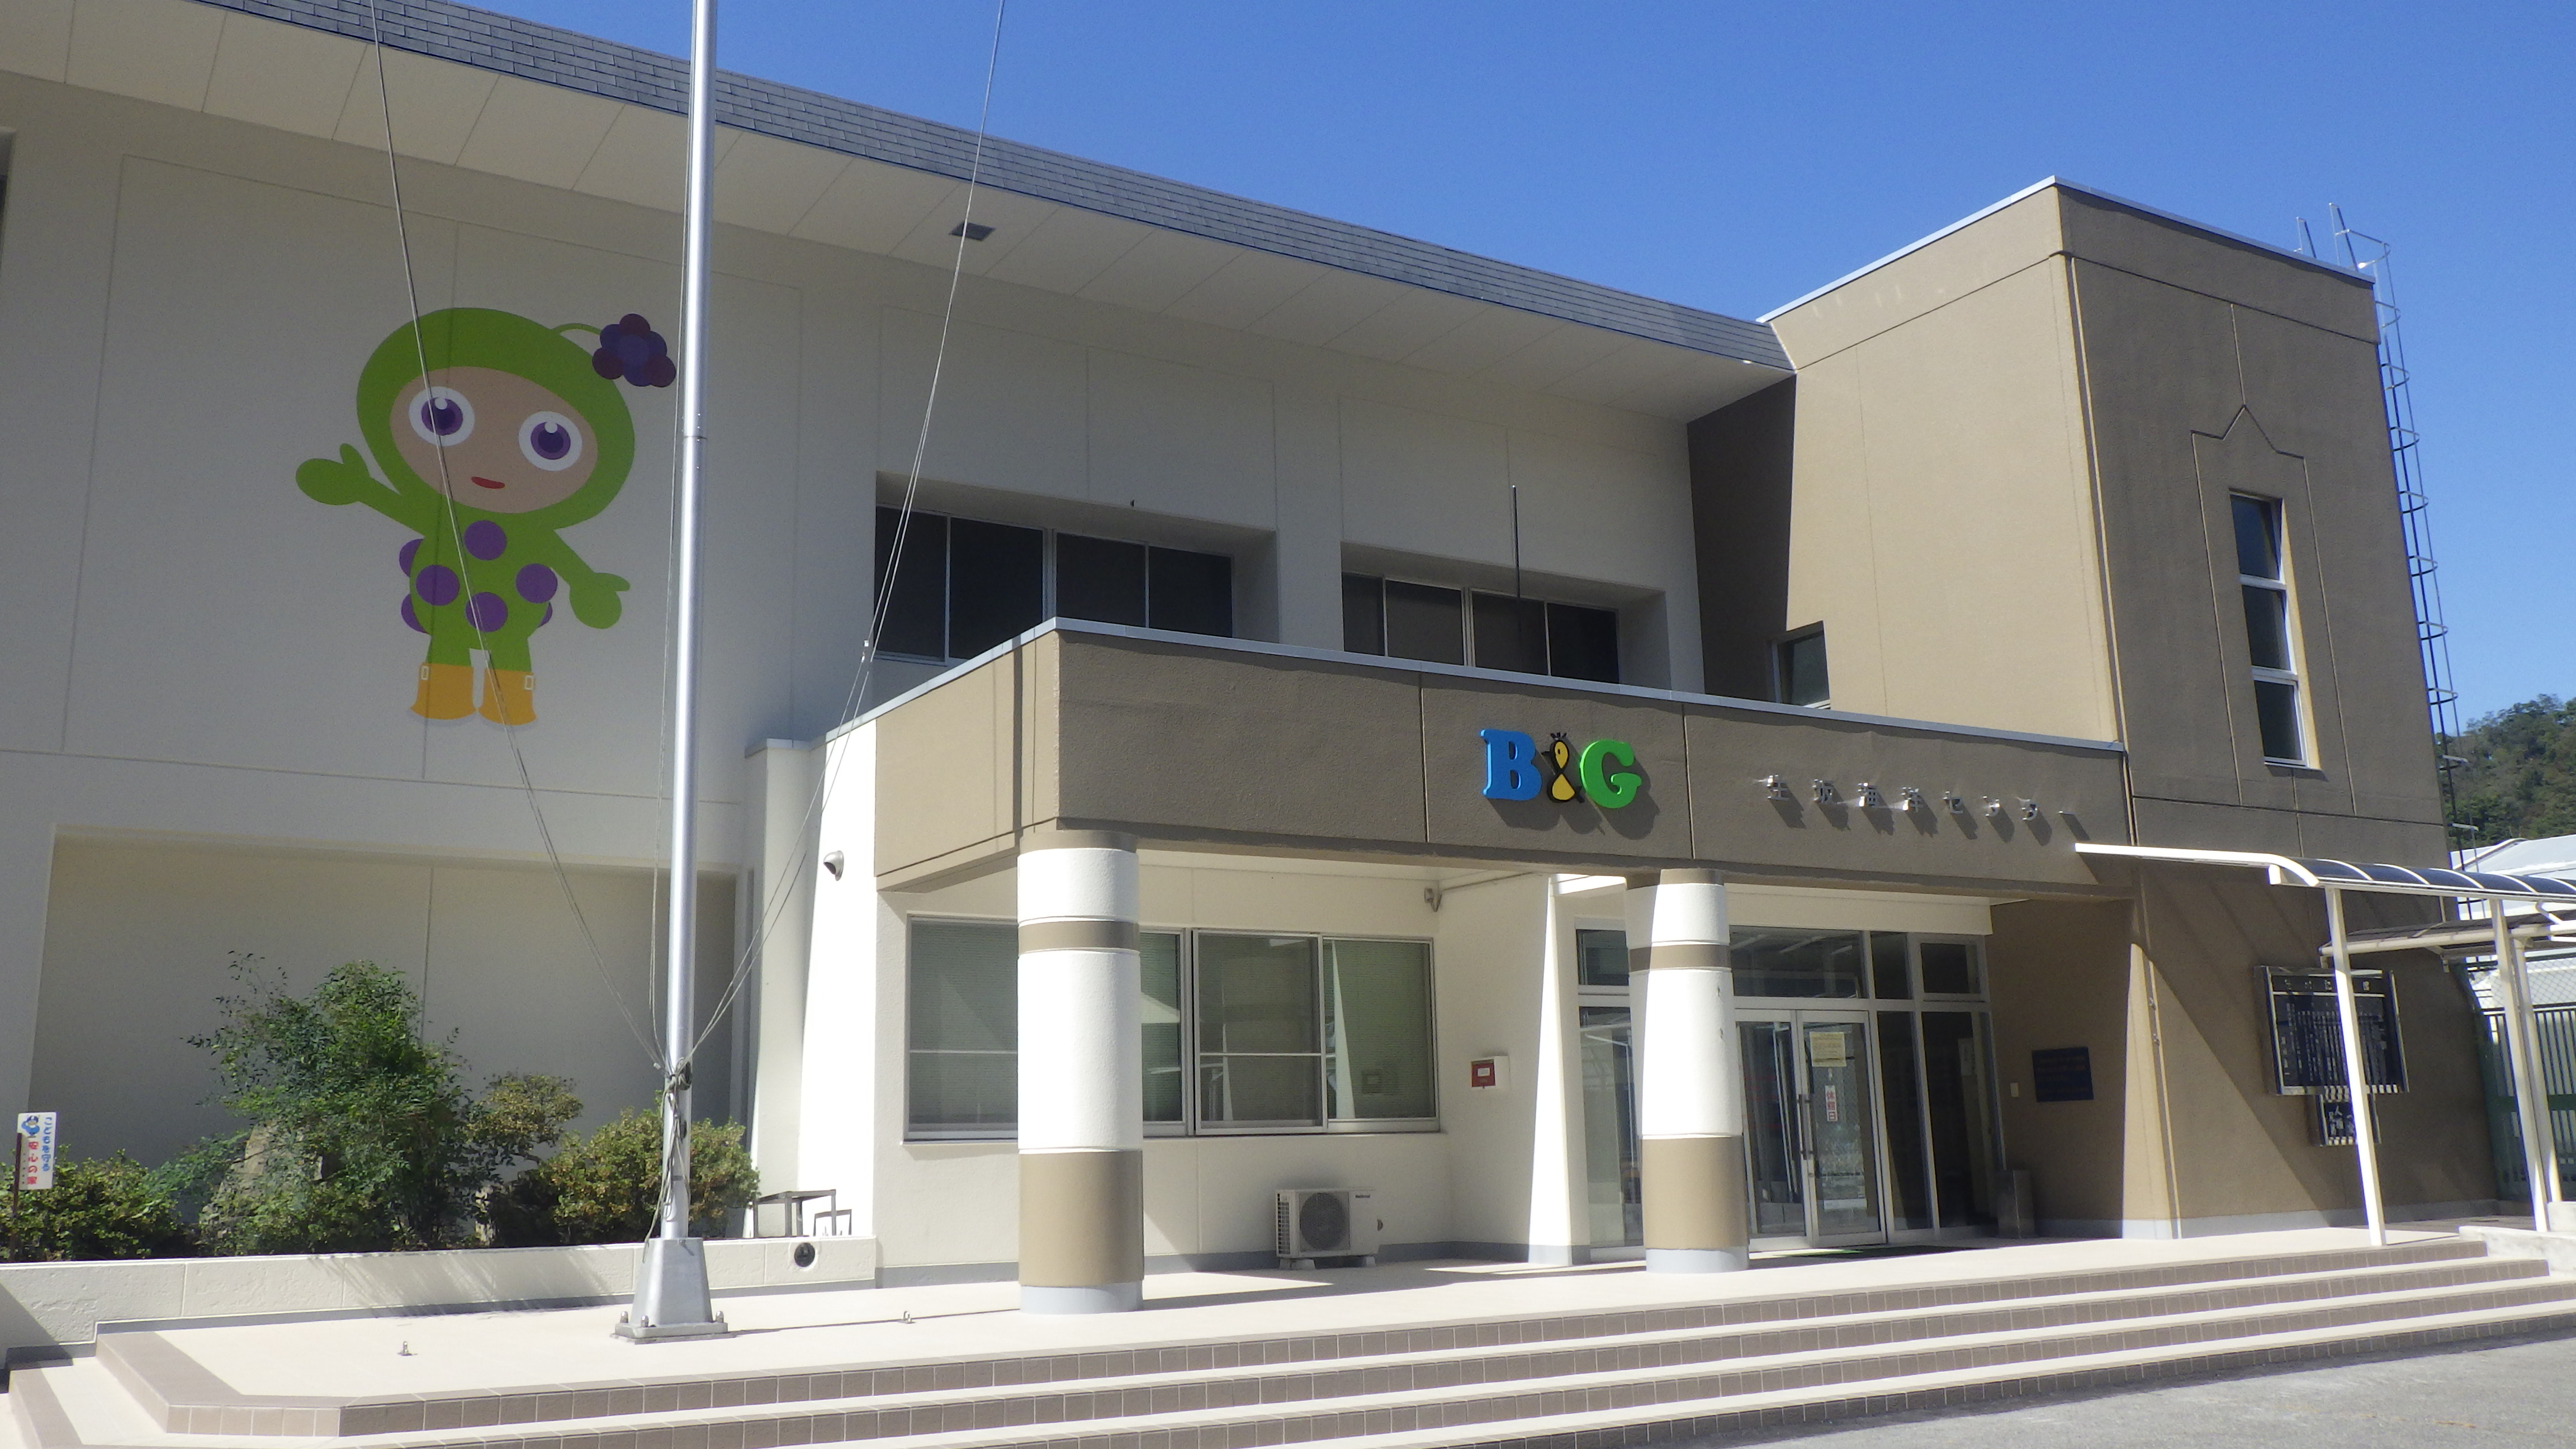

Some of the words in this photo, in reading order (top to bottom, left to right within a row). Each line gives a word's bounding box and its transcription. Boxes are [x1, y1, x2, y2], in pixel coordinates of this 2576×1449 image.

[1480, 728, 1642, 809] B&G
[1827, 1091, 1837, 1120] 休館日
[27, 1141, 39, 1185] 安心の家
[41, 1117, 53, 1172] こどもを守る
